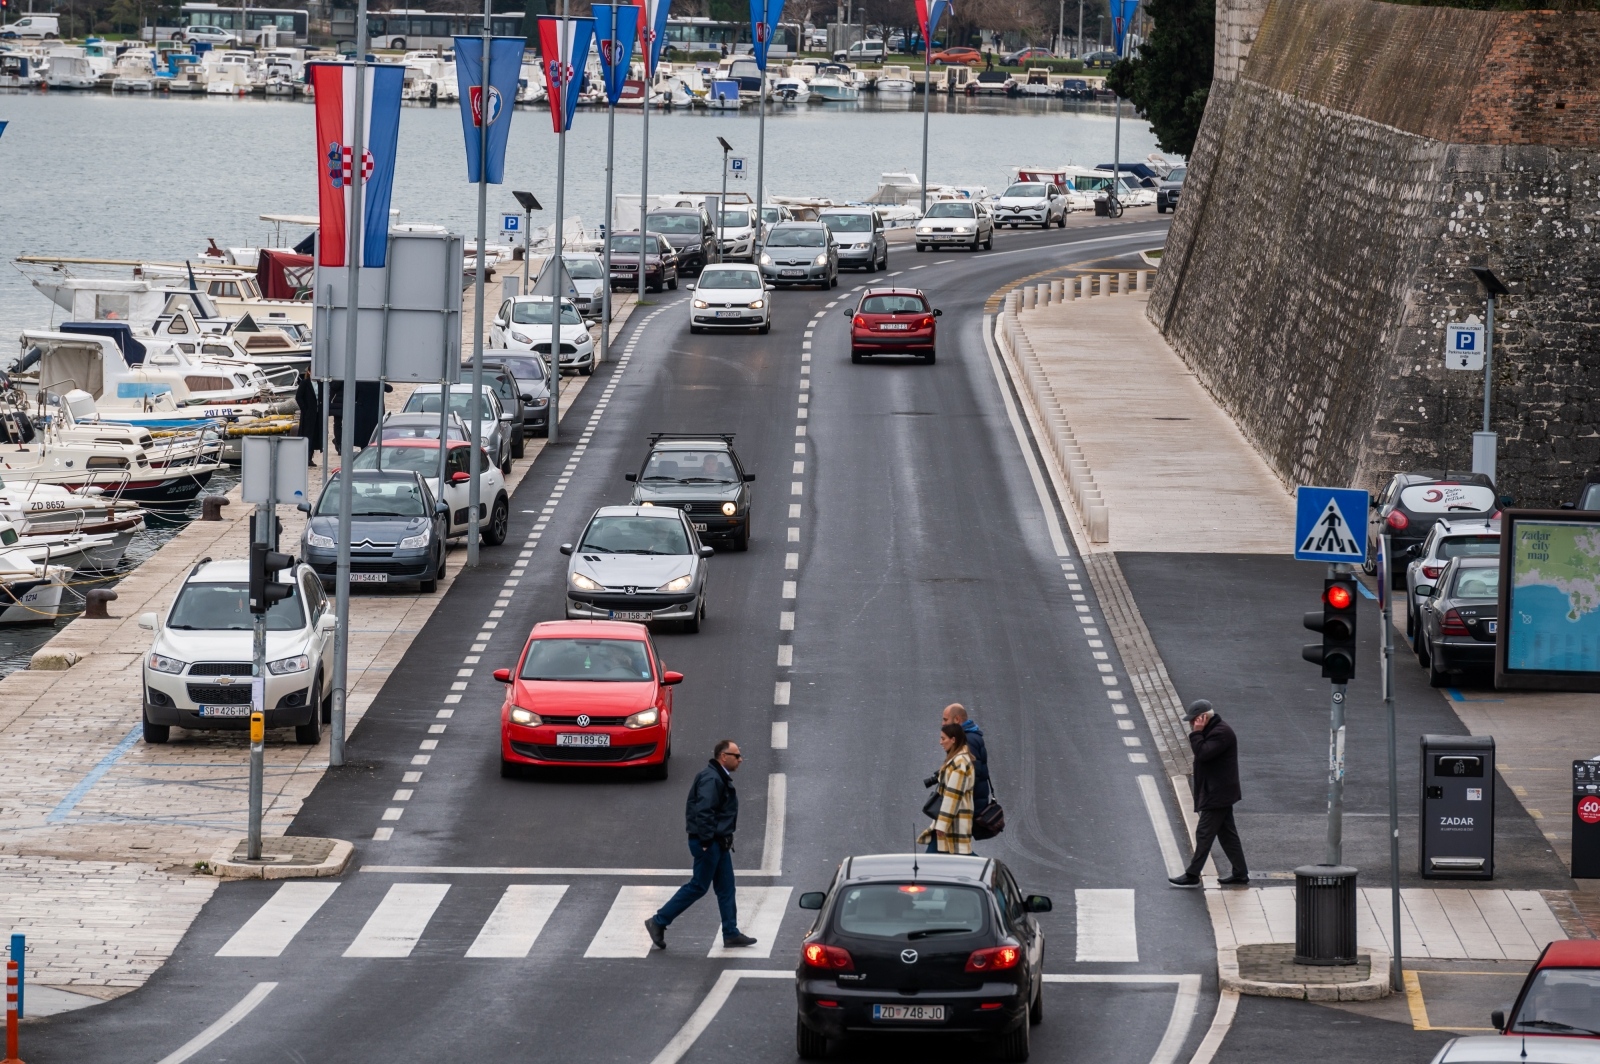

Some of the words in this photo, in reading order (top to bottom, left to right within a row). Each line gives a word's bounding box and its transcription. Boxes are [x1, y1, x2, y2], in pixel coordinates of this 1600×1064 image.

[508, 219, 516, 228] P
[1461, 334, 1471, 348] P
[204, 409, 218, 417] 207
[31, 502, 43, 510] ZD
[46, 501, 65, 509] 8652
[1521, 530, 1550, 540] Zadar
[1532, 541, 1550, 552] city
[1528, 552, 1549, 561] map
[205, 706, 215, 715] SB
[220, 707, 249, 716] 426-HC
[562, 735, 573, 744] ZD
[580, 735, 609, 744] 189-GZ
[1440, 817, 1474, 826] ZADAR
[882, 1007, 895, 1018] ZD
[903, 1007, 942, 1019] 748-JO
